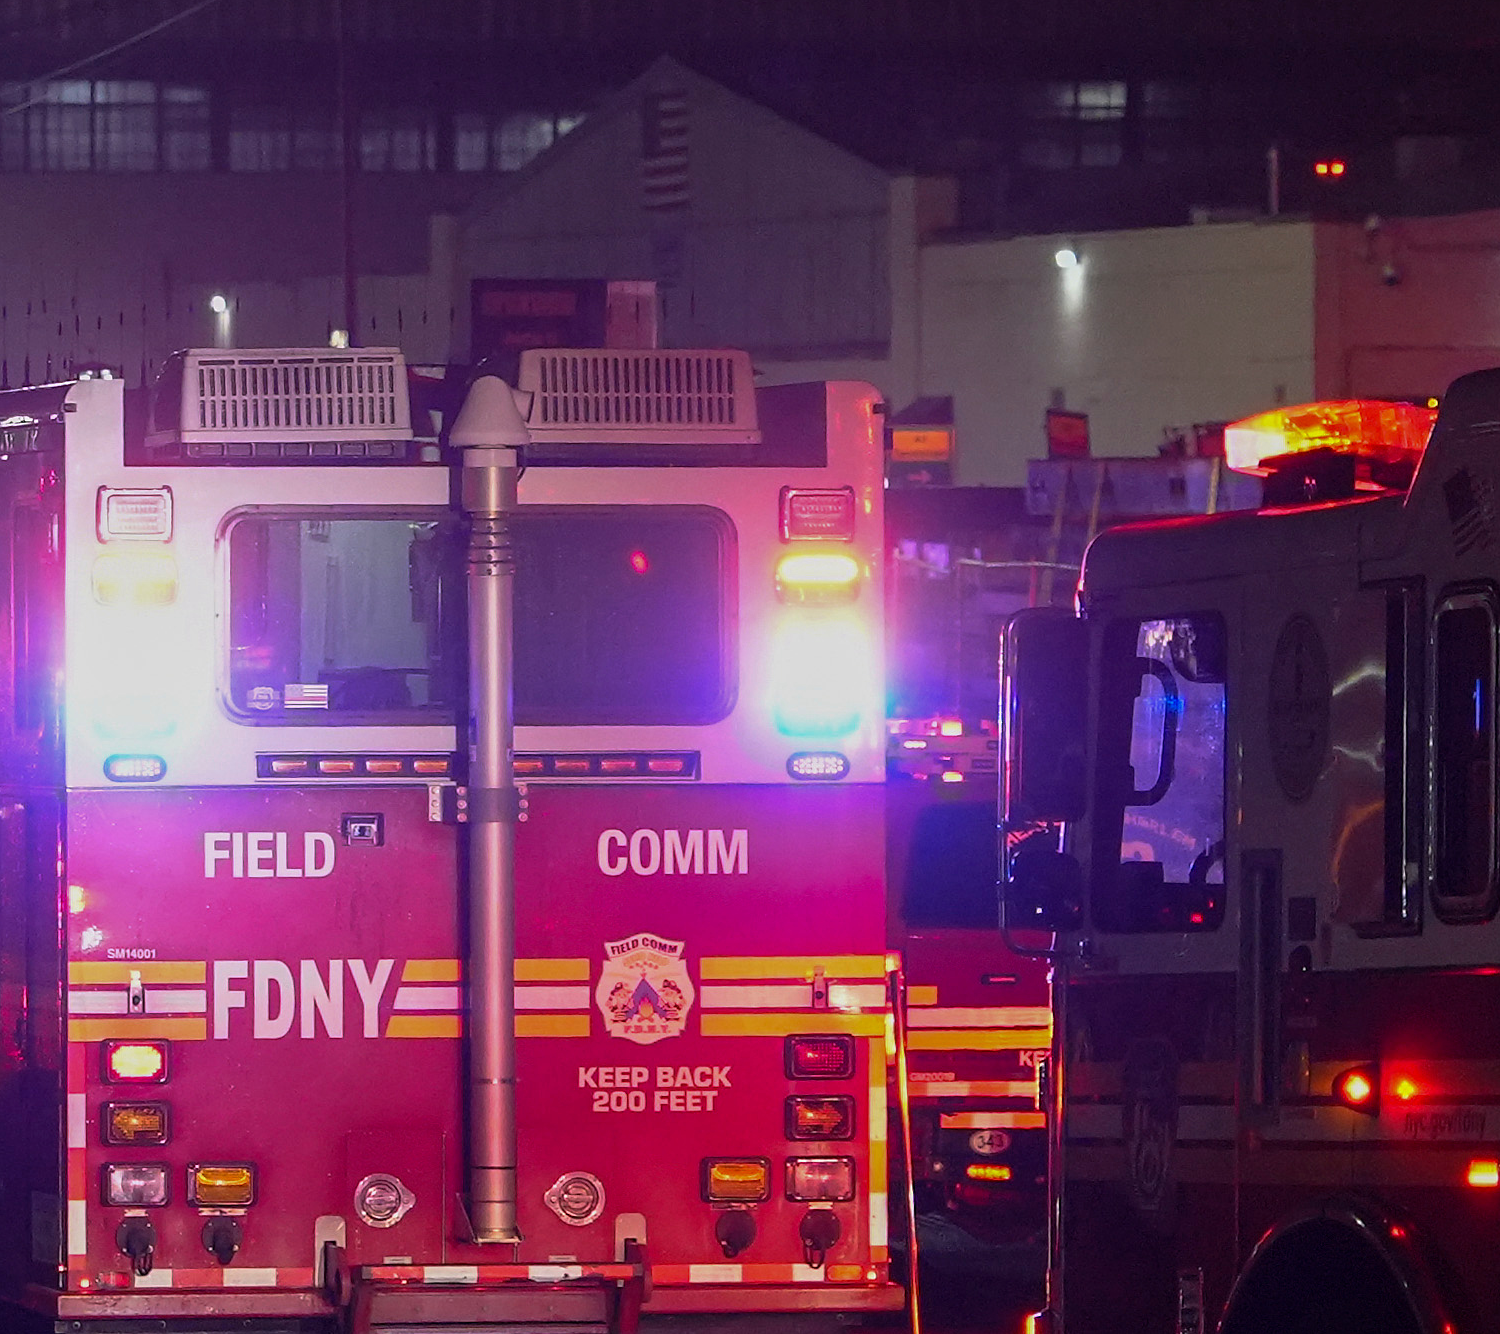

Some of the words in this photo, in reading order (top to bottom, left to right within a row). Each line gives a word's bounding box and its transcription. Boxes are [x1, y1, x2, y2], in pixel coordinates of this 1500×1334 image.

[203, 831, 336, 879] FIELD
[598, 828, 749, 877] COMM
[107, 948, 156, 960] SM14001
[610, 938, 639, 956] FIELD
[641, 936, 679, 954] COMM
[212, 958, 396, 1040] FDNY
[578, 1066, 649, 1088] KEEP
[656, 1066, 732, 1088] BACK
[592, 1091, 646, 1112] 200
[654, 1091, 718, 1112] FEET
[977, 1134, 1004, 1150] 343
